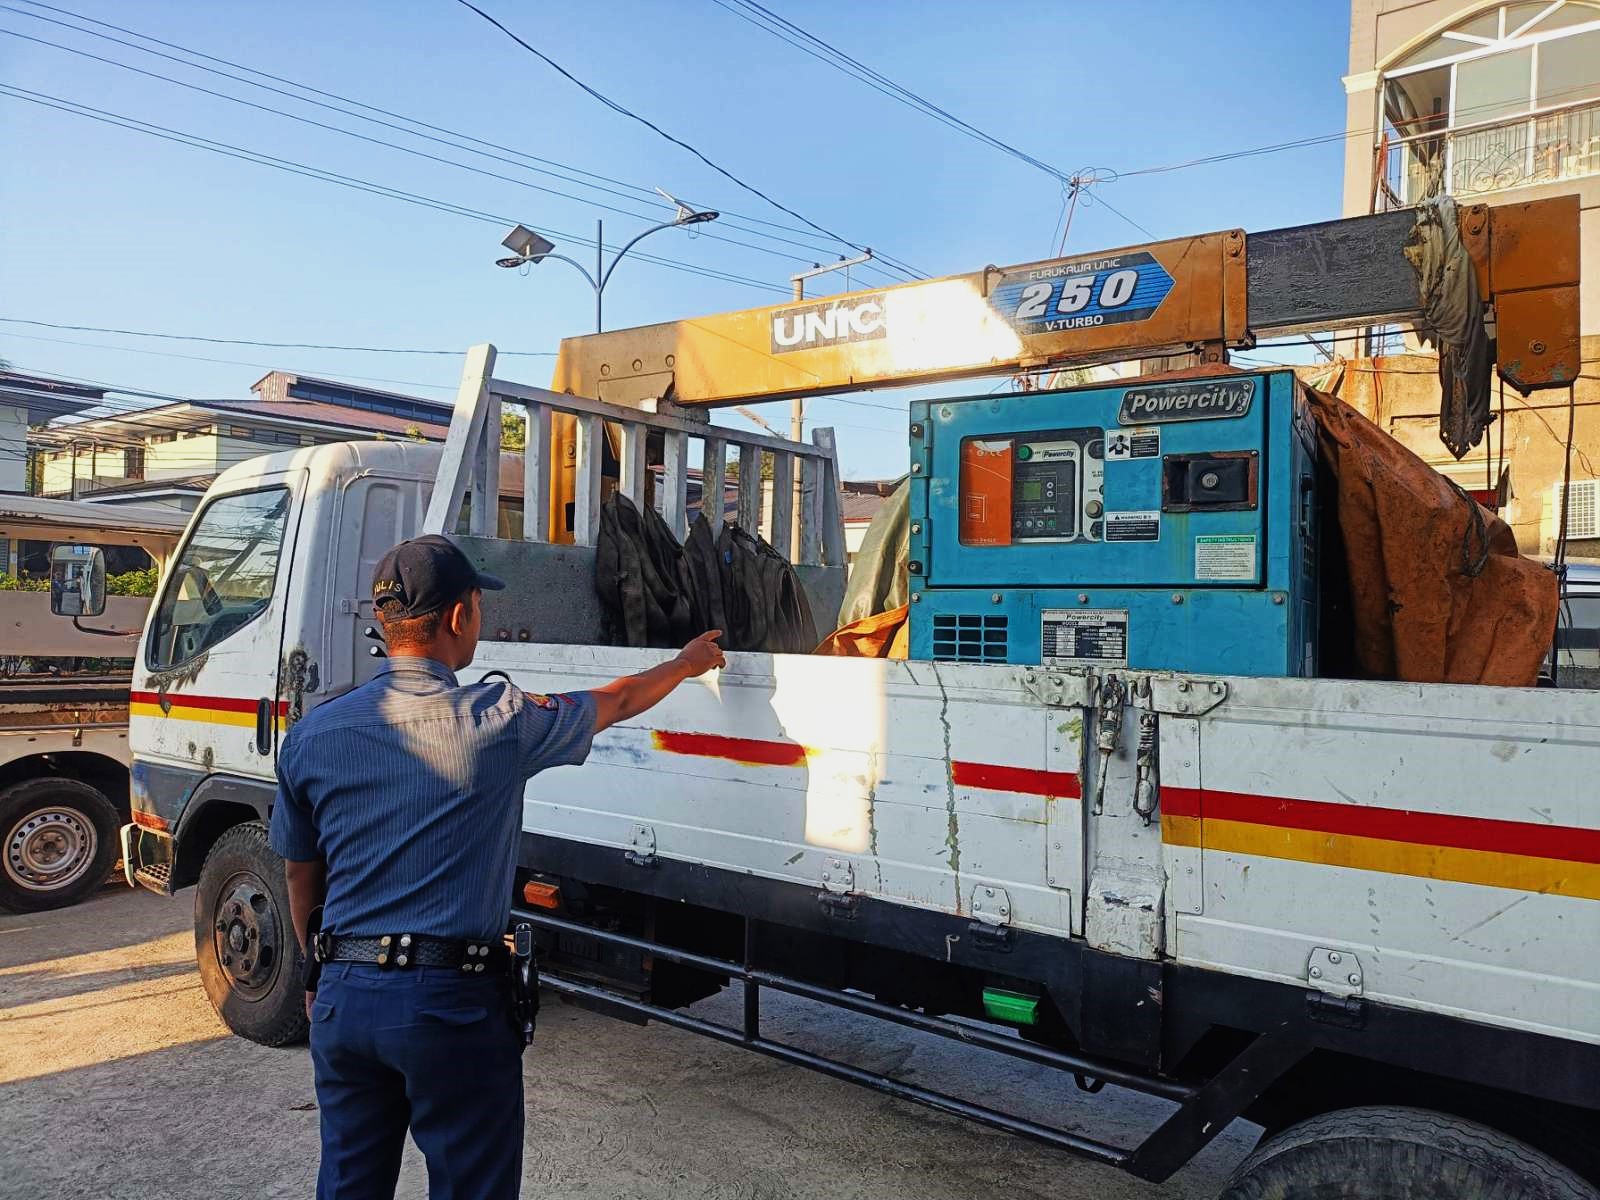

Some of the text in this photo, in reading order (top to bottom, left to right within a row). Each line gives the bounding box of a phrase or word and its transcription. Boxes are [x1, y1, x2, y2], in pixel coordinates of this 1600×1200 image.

[1029, 263, 1092, 280] FURUKAWA
[1016, 270, 1138, 319] 250
[773, 301, 883, 346] UNIC
[1045, 314, 1104, 331] V-TURBO
[1130, 387, 1240, 413] Powercity
[1043, 449, 1076, 458] Powercity
